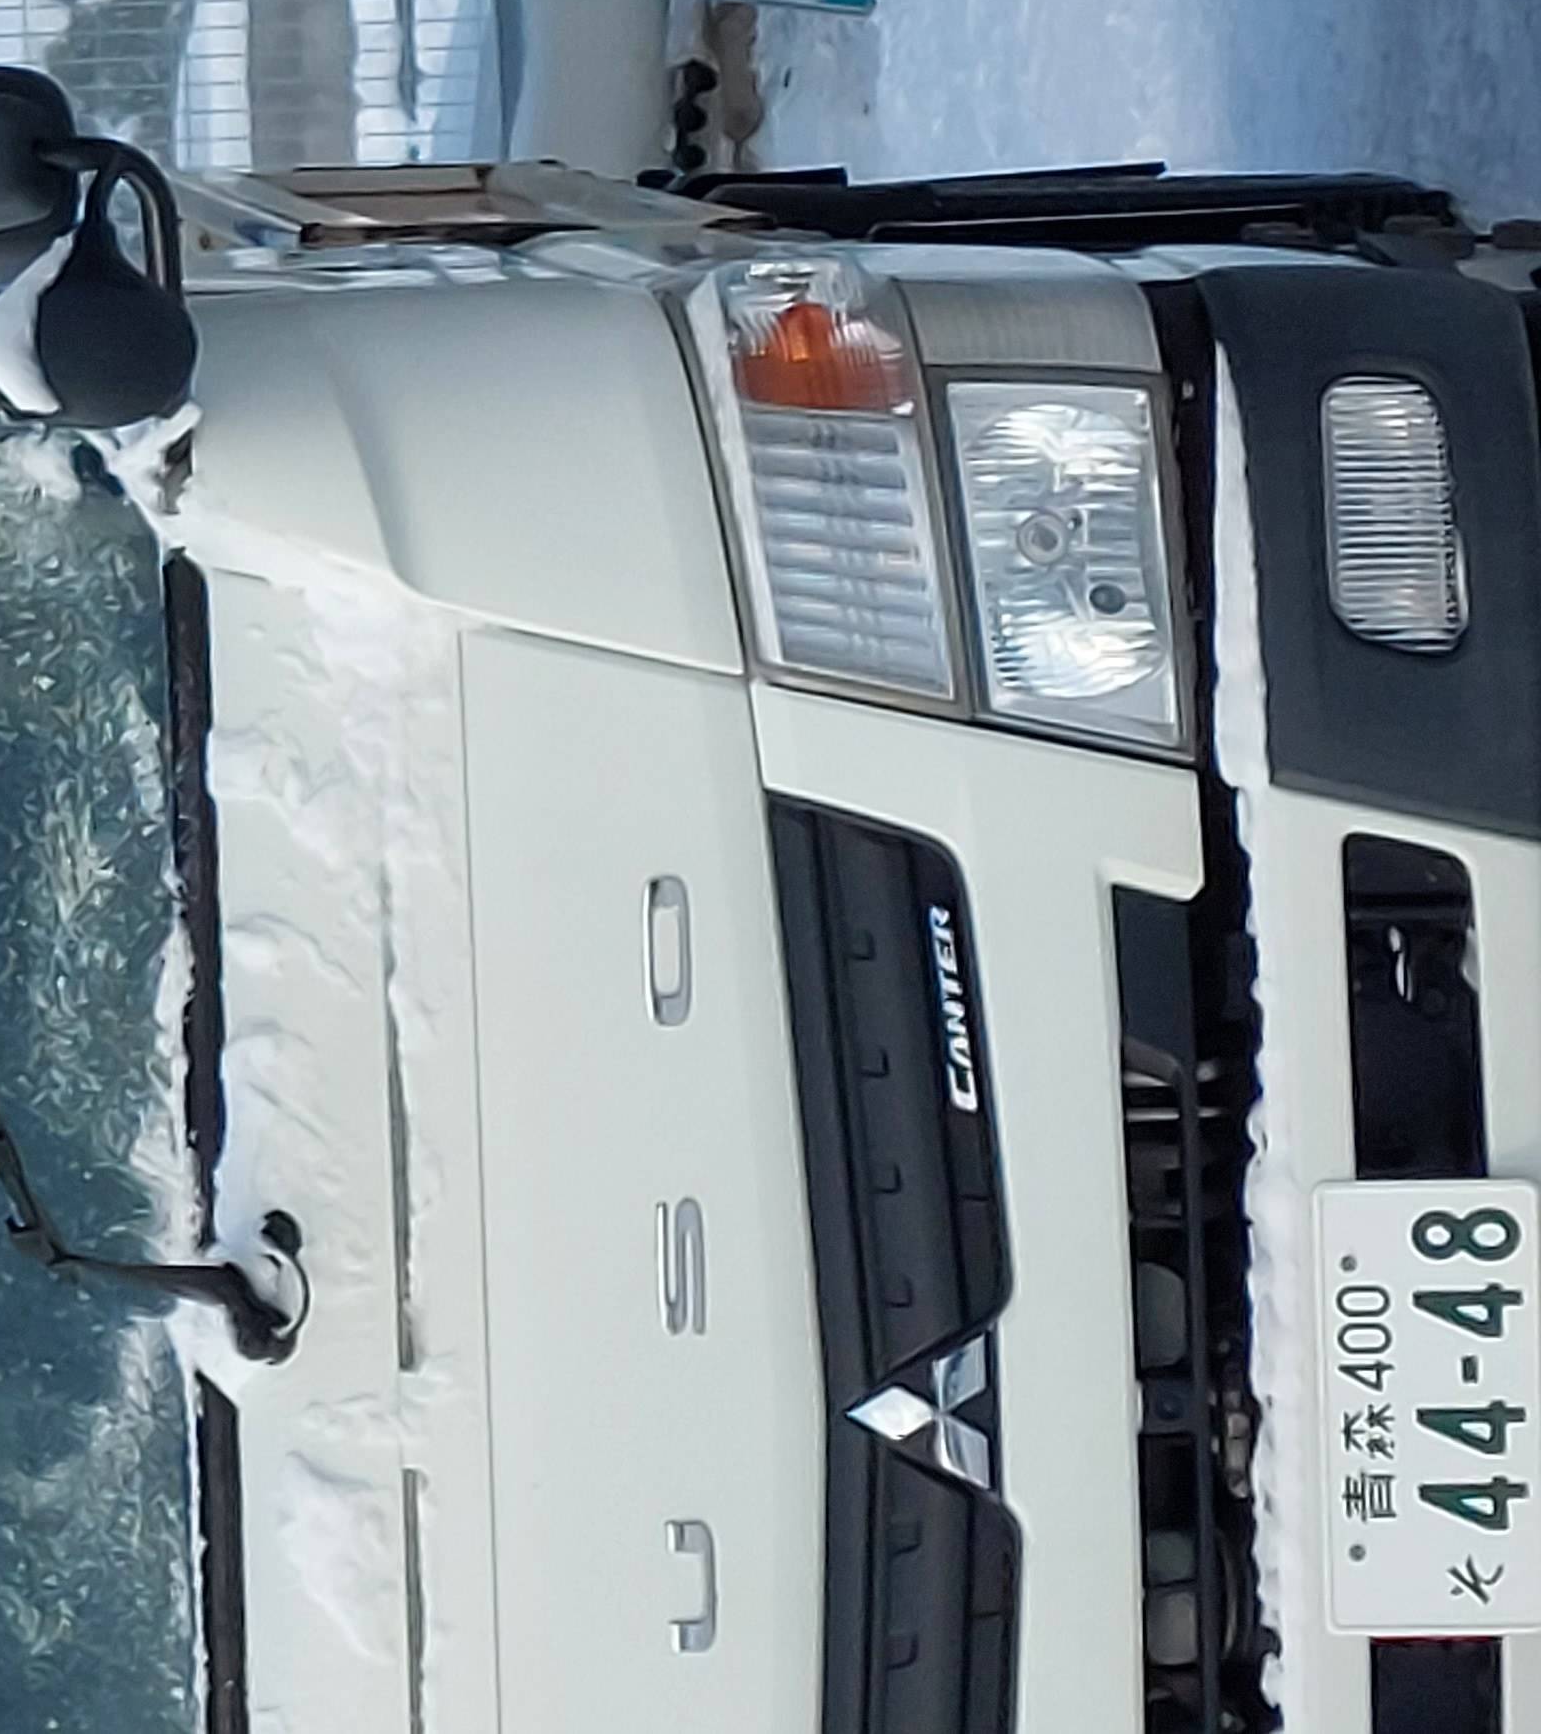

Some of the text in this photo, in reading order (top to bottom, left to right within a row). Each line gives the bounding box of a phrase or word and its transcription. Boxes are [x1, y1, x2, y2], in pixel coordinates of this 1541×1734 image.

[929, 903, 979, 1113] CANTER
[1411, 1206, 1529, 1606] そ 44-48
